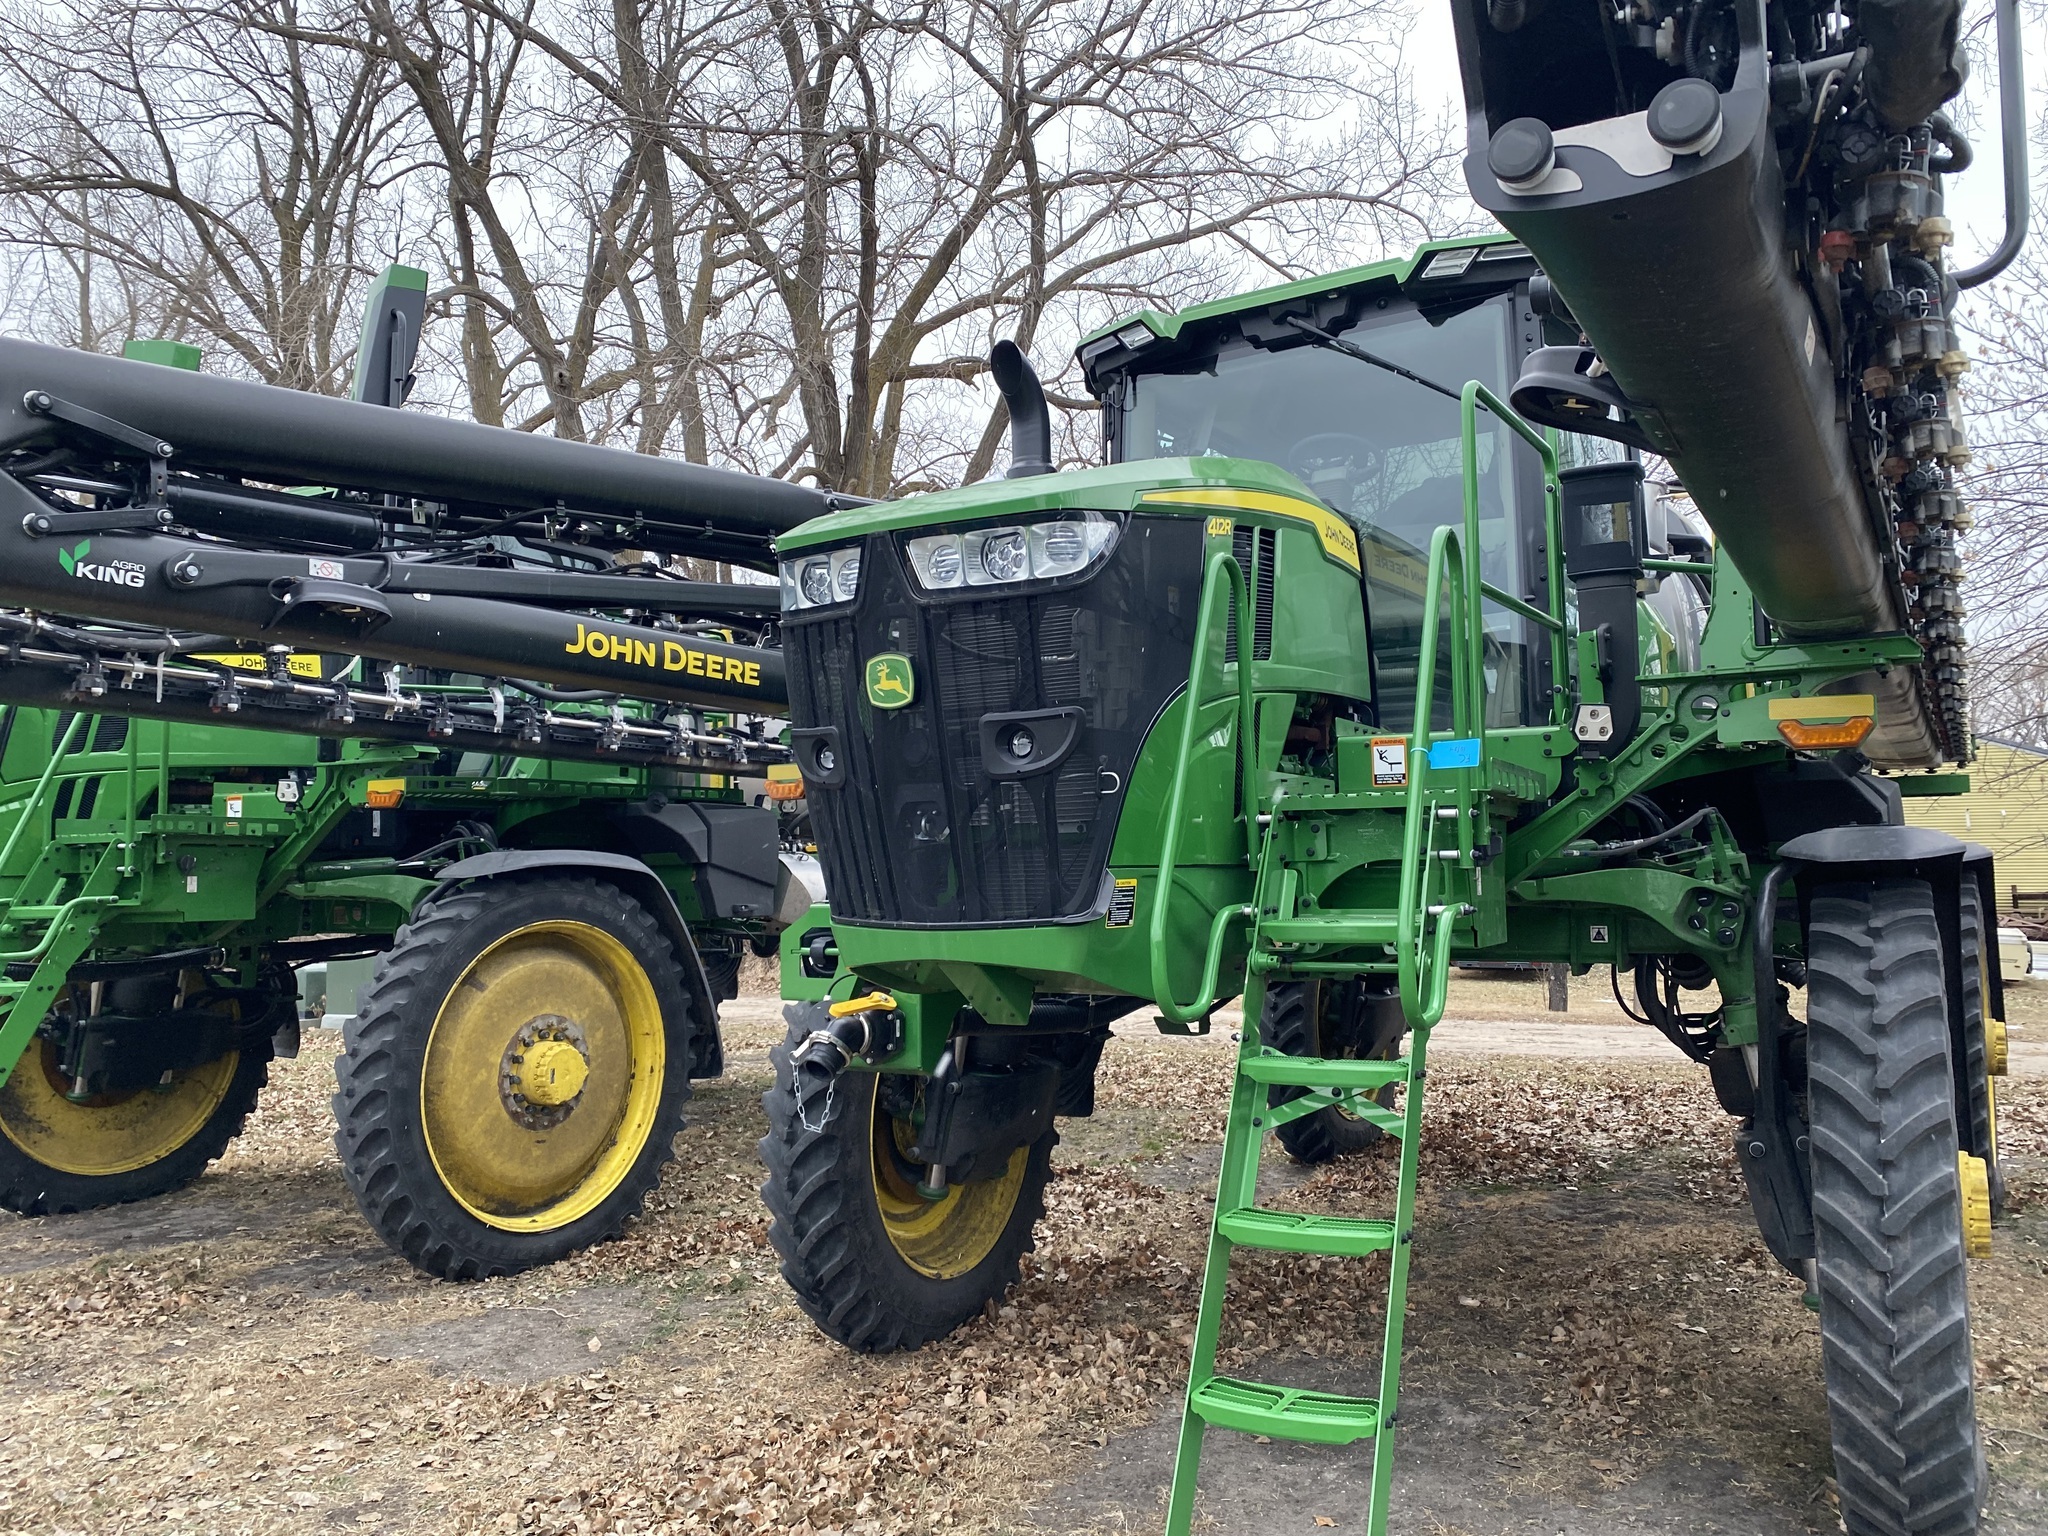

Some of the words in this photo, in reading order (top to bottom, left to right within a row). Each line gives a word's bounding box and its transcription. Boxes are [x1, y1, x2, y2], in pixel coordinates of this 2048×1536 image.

[1208, 517, 1231, 538] 412R
[1324, 521, 1340, 544] JOHN
[1339, 529, 1355, 556] DEERE
[75, 561, 146, 588] KING
[111, 559, 146, 573] AGRO
[565, 623, 656, 668] JOHN
[663, 640, 761, 687] DEERE
